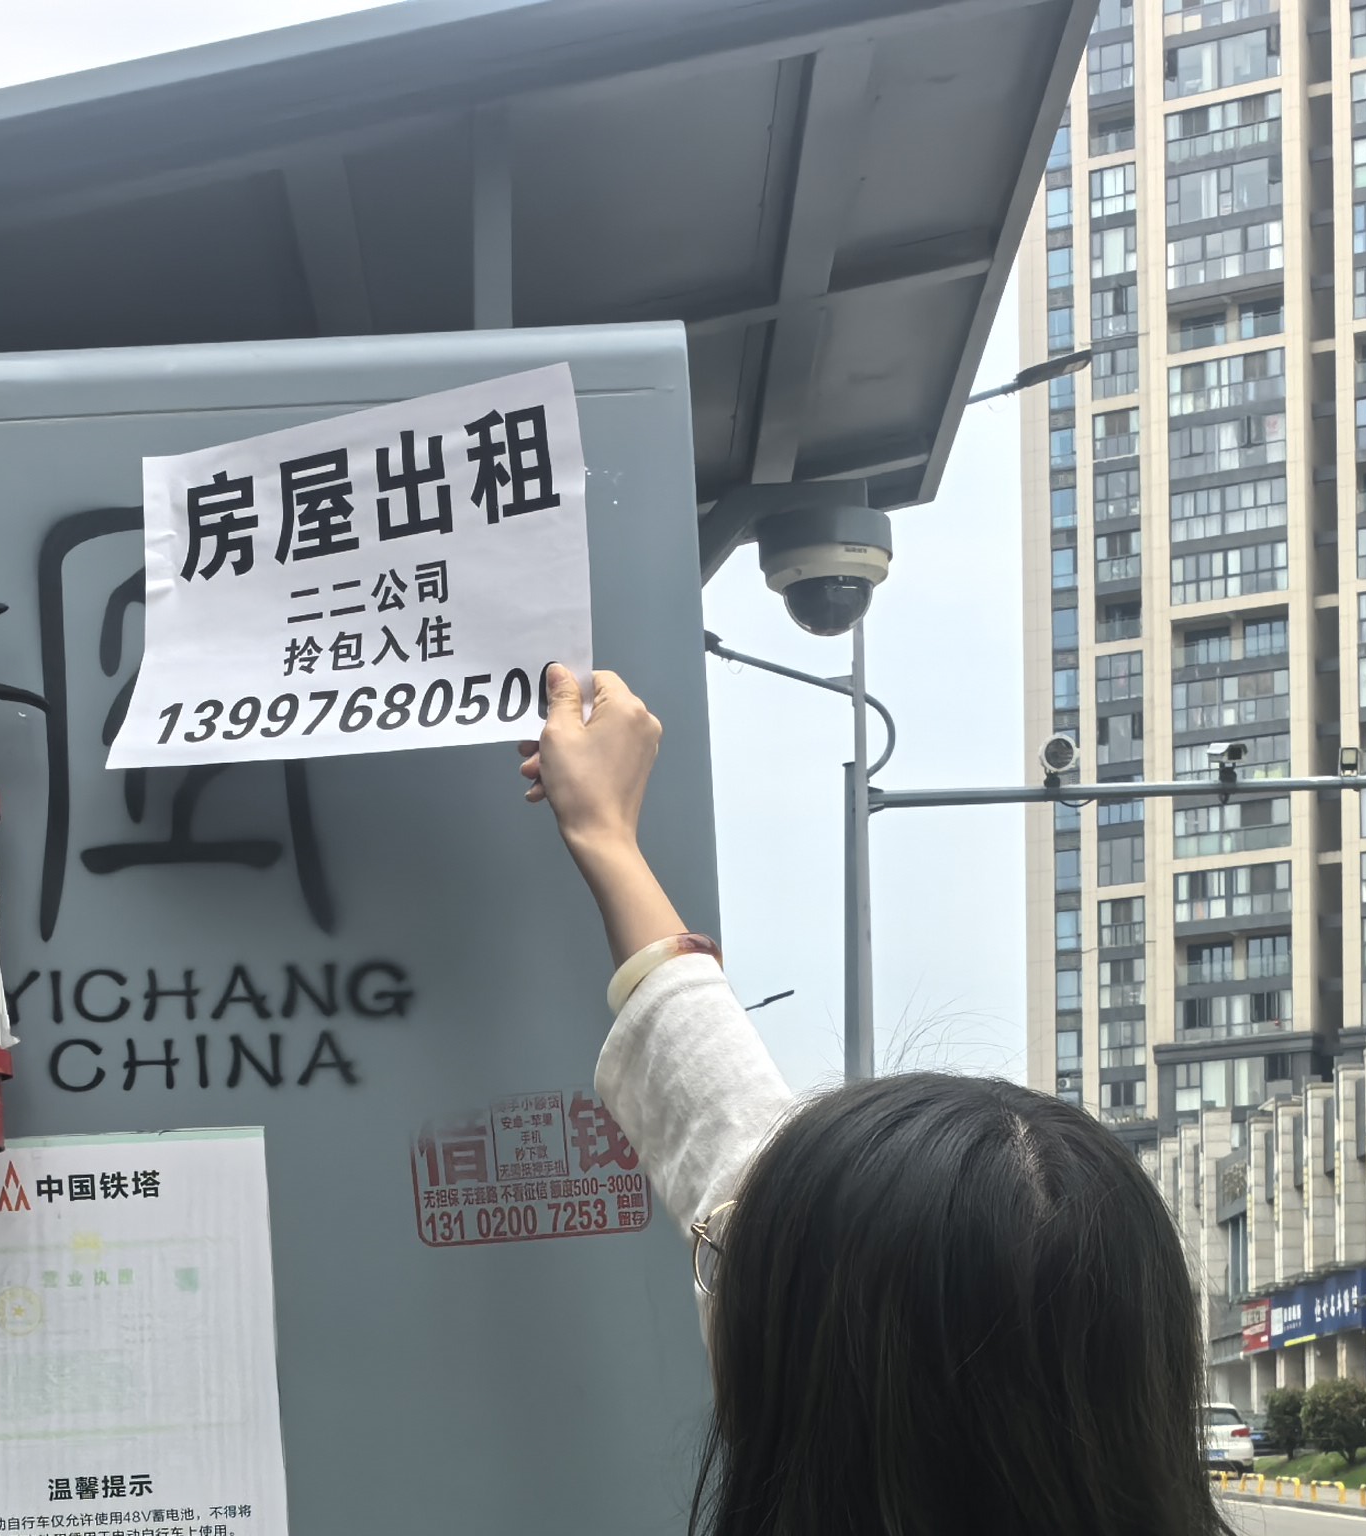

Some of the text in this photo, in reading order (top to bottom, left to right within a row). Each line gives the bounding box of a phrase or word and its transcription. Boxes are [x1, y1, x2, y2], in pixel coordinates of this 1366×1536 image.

[180, 404, 560, 582] 房屋出租
[287, 560, 450, 624] 二二公司
[283, 616, 455, 677] 拎包入住
[49, 1030, 361, 1092] CHINA
[36, 1169, 161, 1203] 中国铁塔
[426, 1198, 608, 1242] 131 0200 7253
[48, 1473, 153, 1501] 温馨提示
